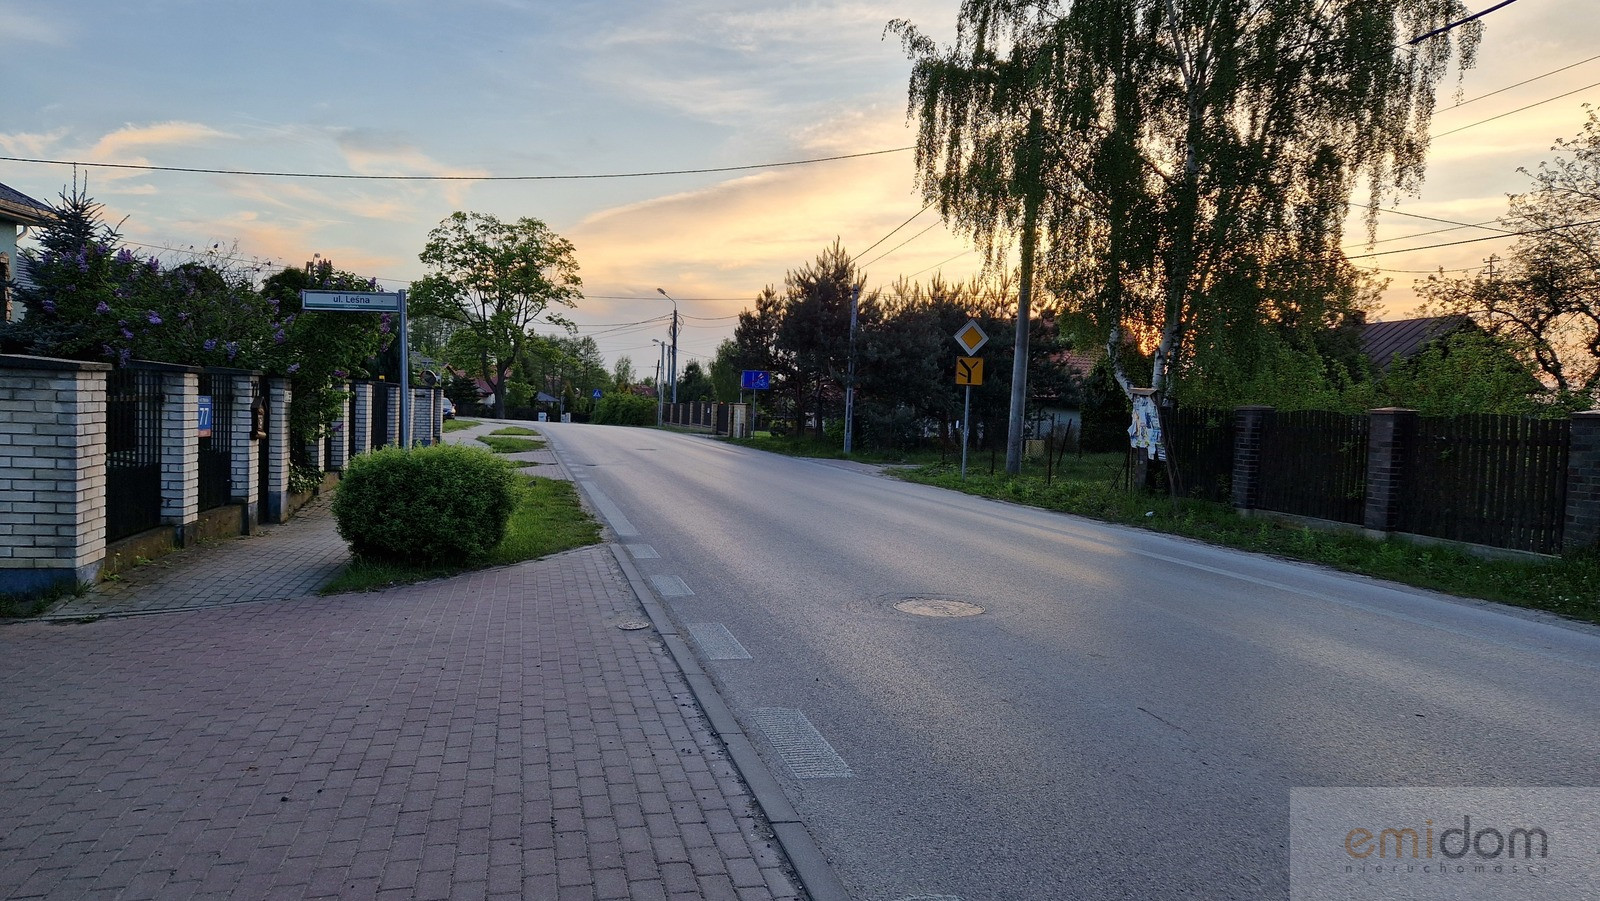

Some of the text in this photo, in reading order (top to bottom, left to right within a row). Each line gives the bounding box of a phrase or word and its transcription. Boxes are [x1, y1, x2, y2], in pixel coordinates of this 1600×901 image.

[333, 295, 370, 304] ul. Leśna
[199, 407, 210, 426] 77
